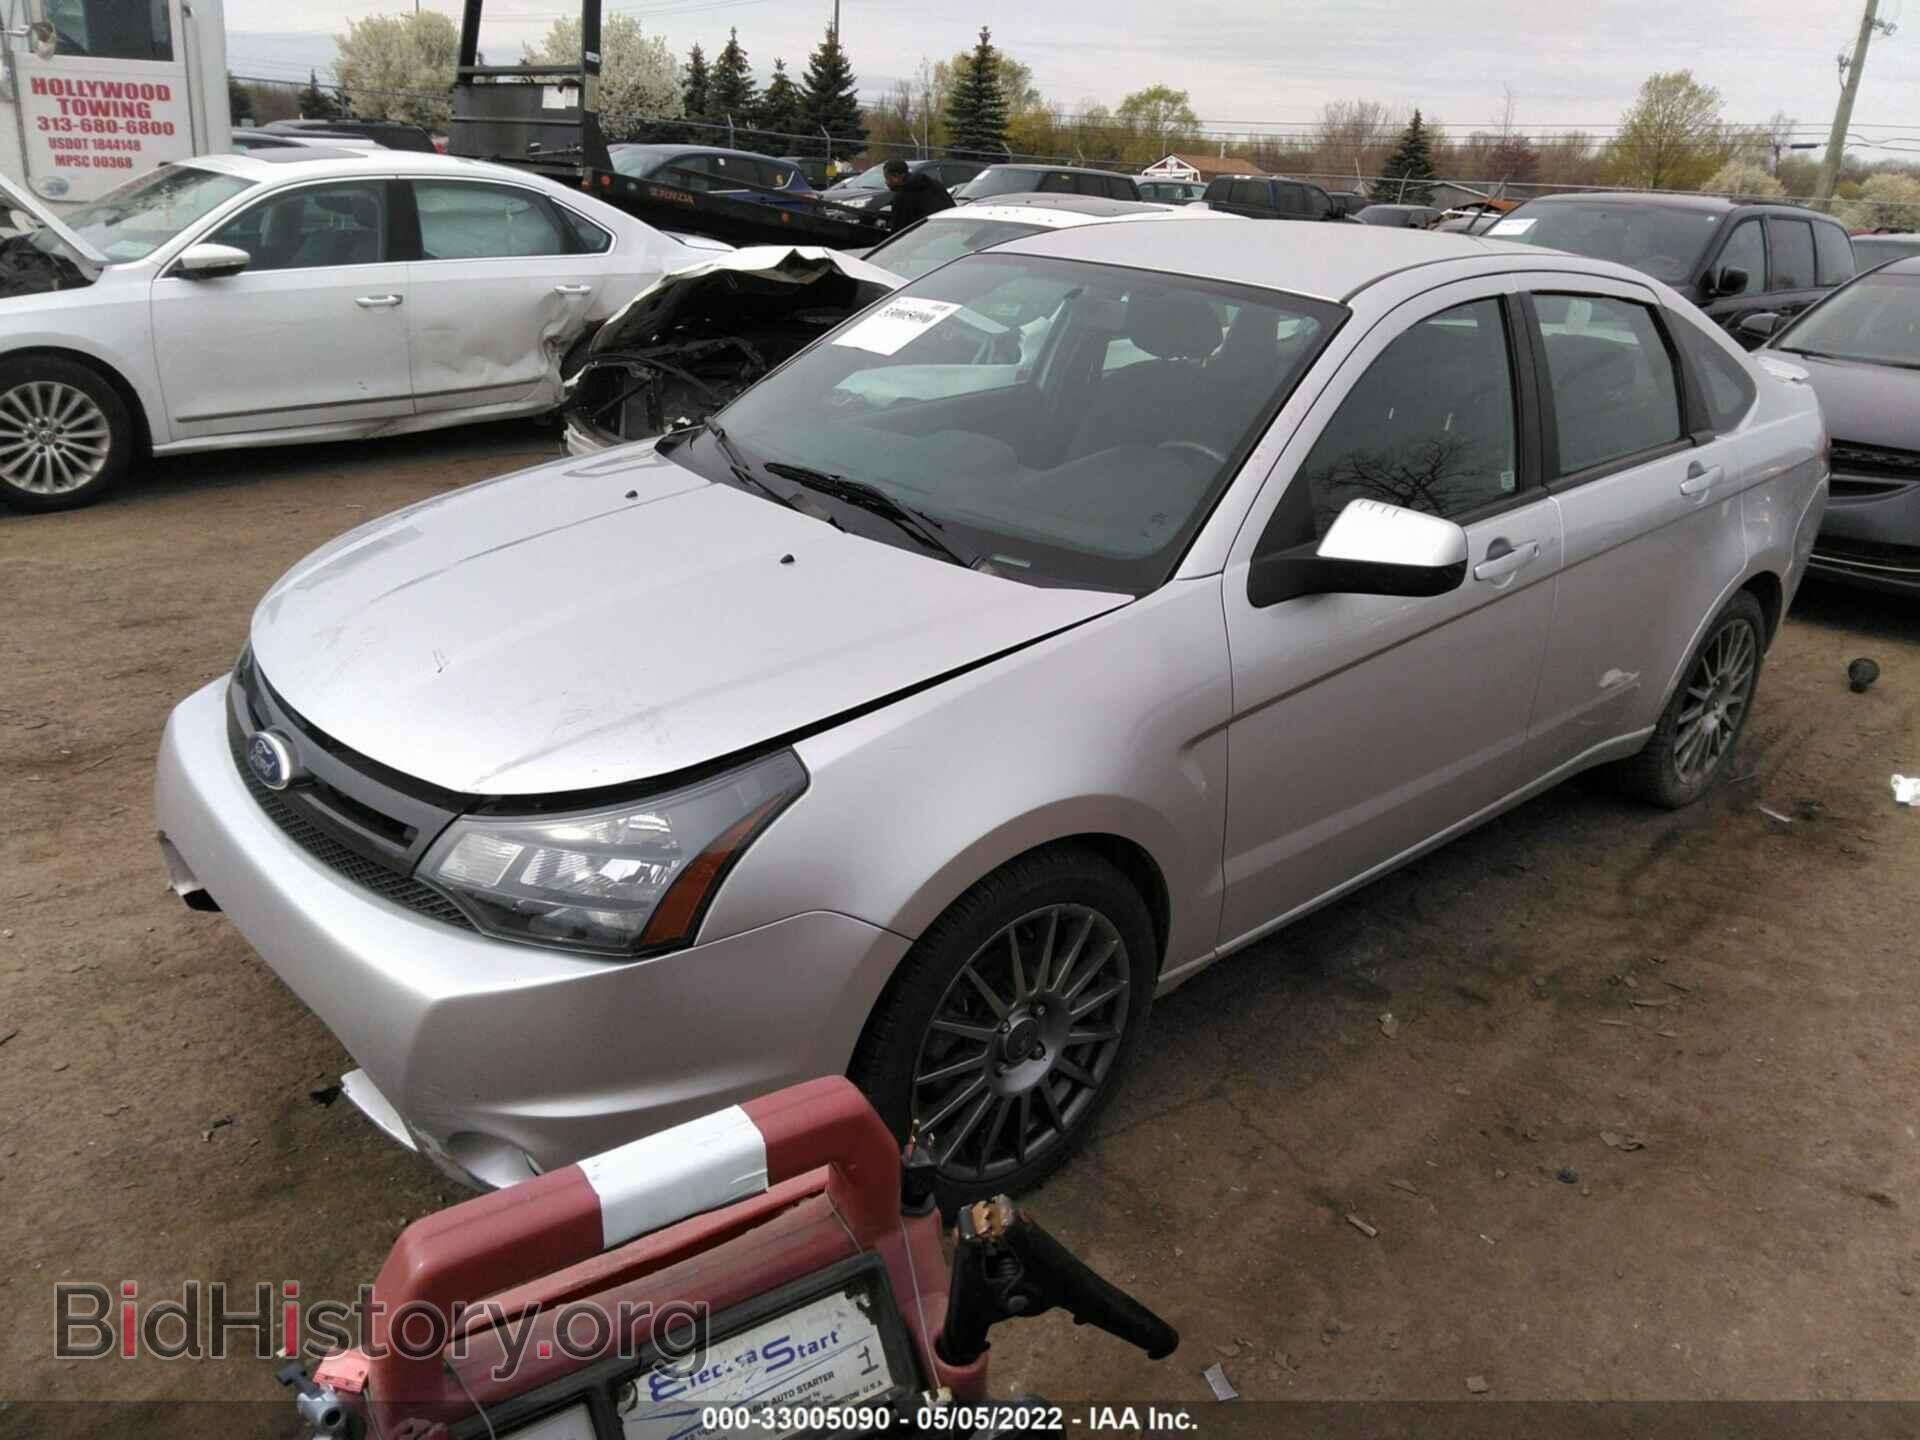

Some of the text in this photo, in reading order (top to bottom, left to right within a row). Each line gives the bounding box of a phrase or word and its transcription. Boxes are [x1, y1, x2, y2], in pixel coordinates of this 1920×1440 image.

[30, 77, 171, 101] HOLLYWOOD
[56, 98, 152, 119] TOWING
[37, 116, 175, 135] 313-680-6800
[48, 137, 142, 151] USDOT 1844148
[55, 154, 90, 167] MPSC
[771, 1389, 796, 1406] AUTO
[796, 1371, 835, 1394] STARTER
